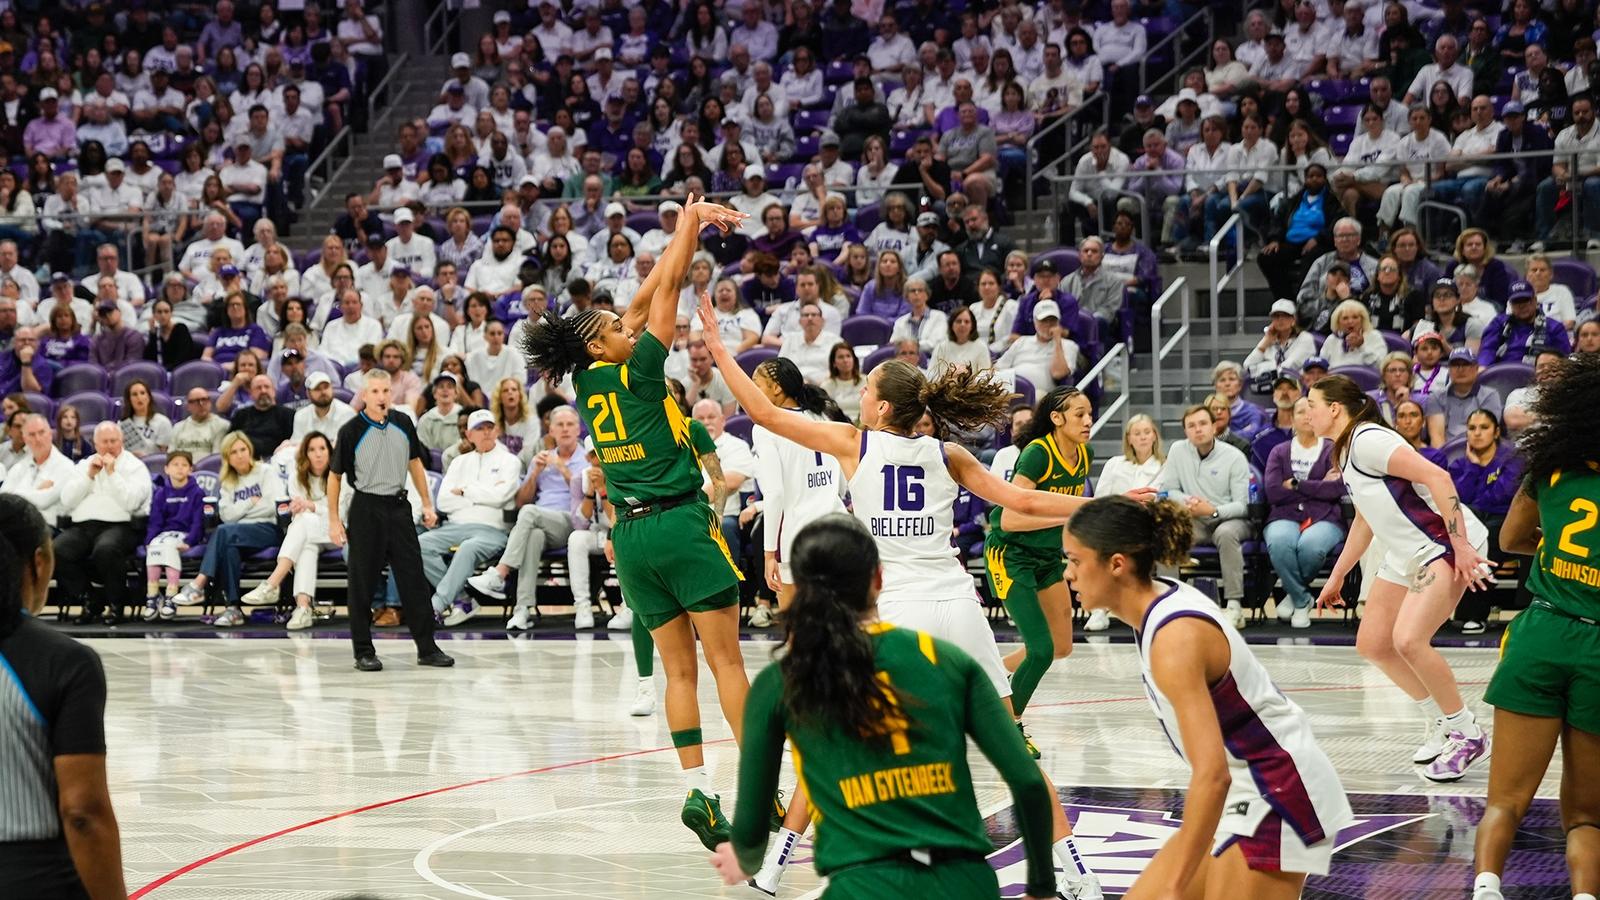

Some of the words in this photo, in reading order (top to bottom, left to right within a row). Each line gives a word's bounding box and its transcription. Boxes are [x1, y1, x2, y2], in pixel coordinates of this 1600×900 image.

[587, 392, 627, 442] 21
[601, 443, 646, 464] JOHNSON
[807, 470, 832, 488] BIGBY
[880, 465, 925, 511] 16
[871, 516, 935, 537] BIELEFELD
[1558, 497, 1599, 558] 2
[839, 774, 876, 808] VAN
[874, 762, 956, 801] GYTENBEEK
